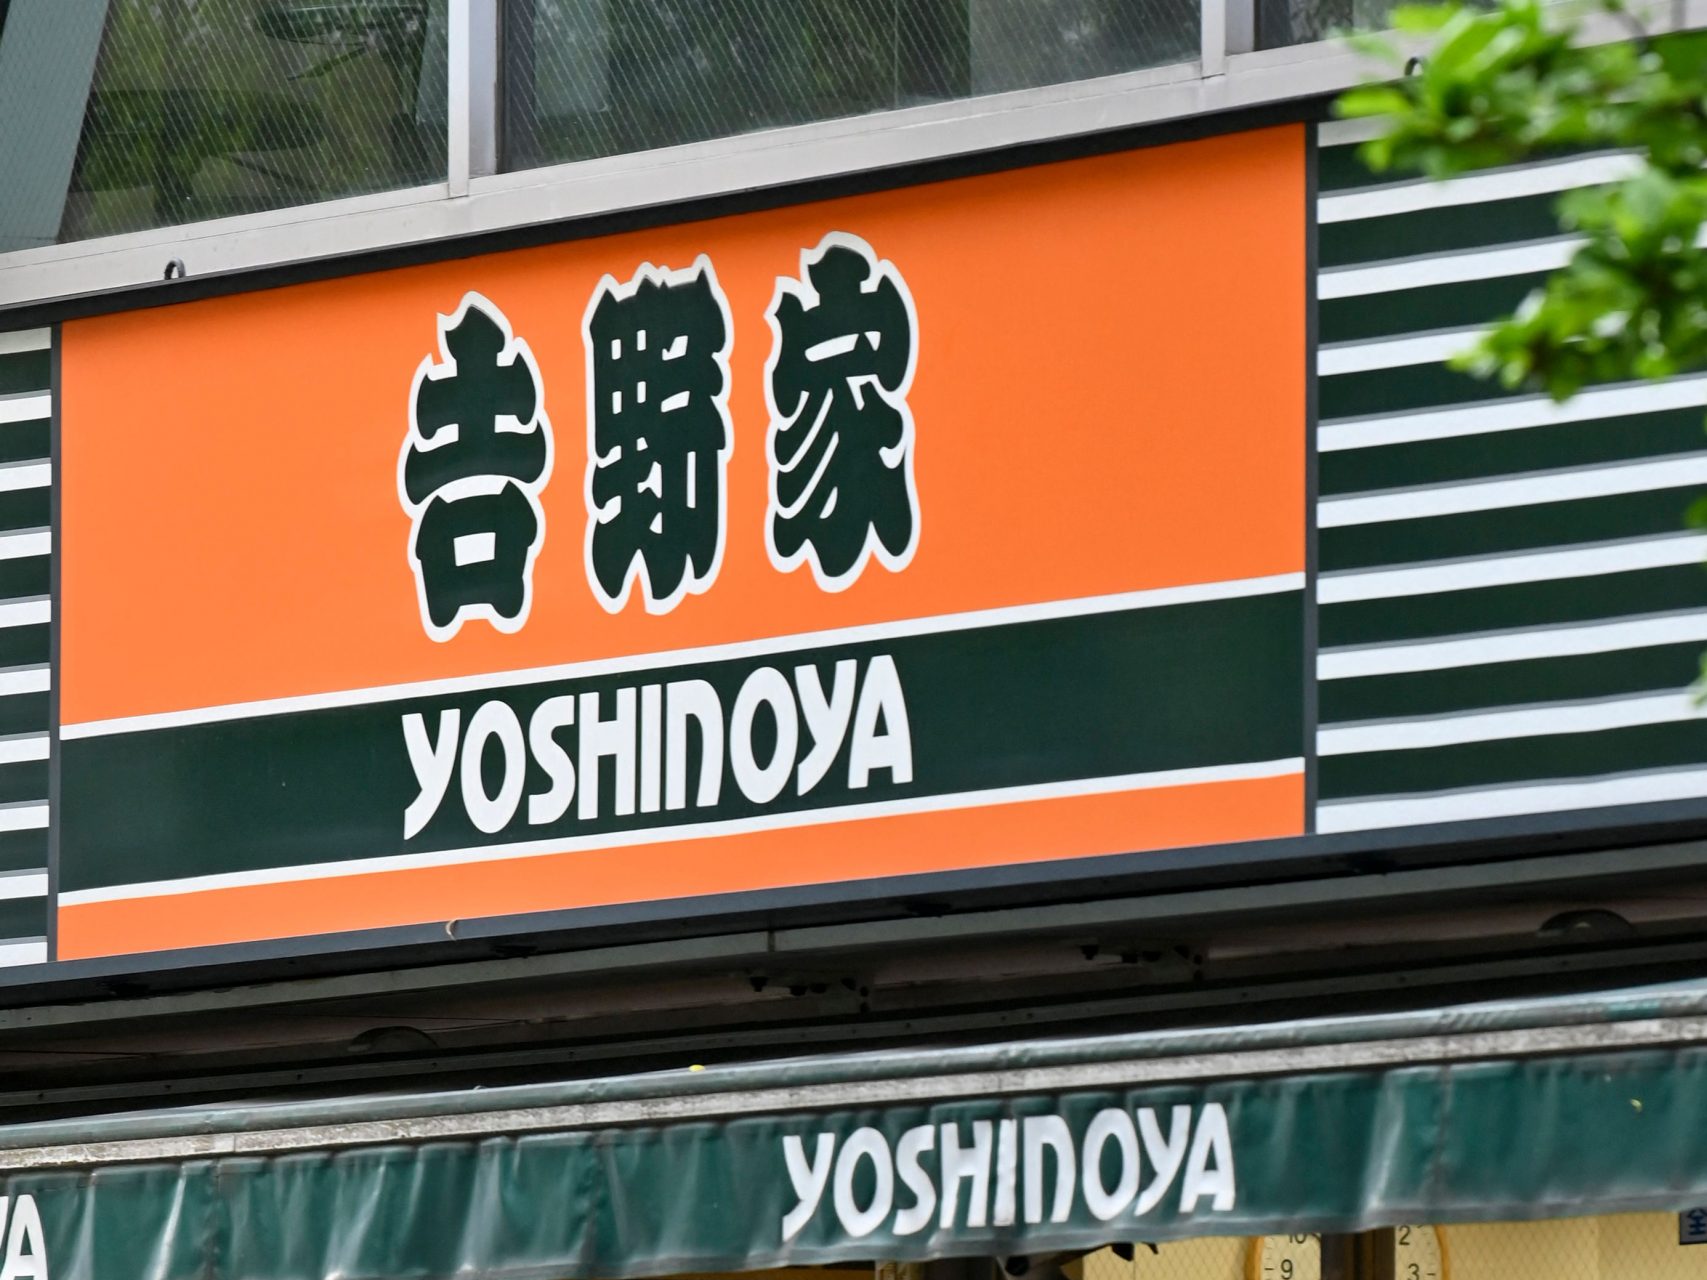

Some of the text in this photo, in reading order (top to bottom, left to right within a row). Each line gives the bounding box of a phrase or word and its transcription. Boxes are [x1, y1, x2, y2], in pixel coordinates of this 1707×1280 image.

[397, 230, 920, 643] 吉野家
[402, 655, 913, 840] YOSHINOYA
[782, 1102, 1236, 1242] YOSHINOYA
[1280, 1259, 1293, 1280] 9
